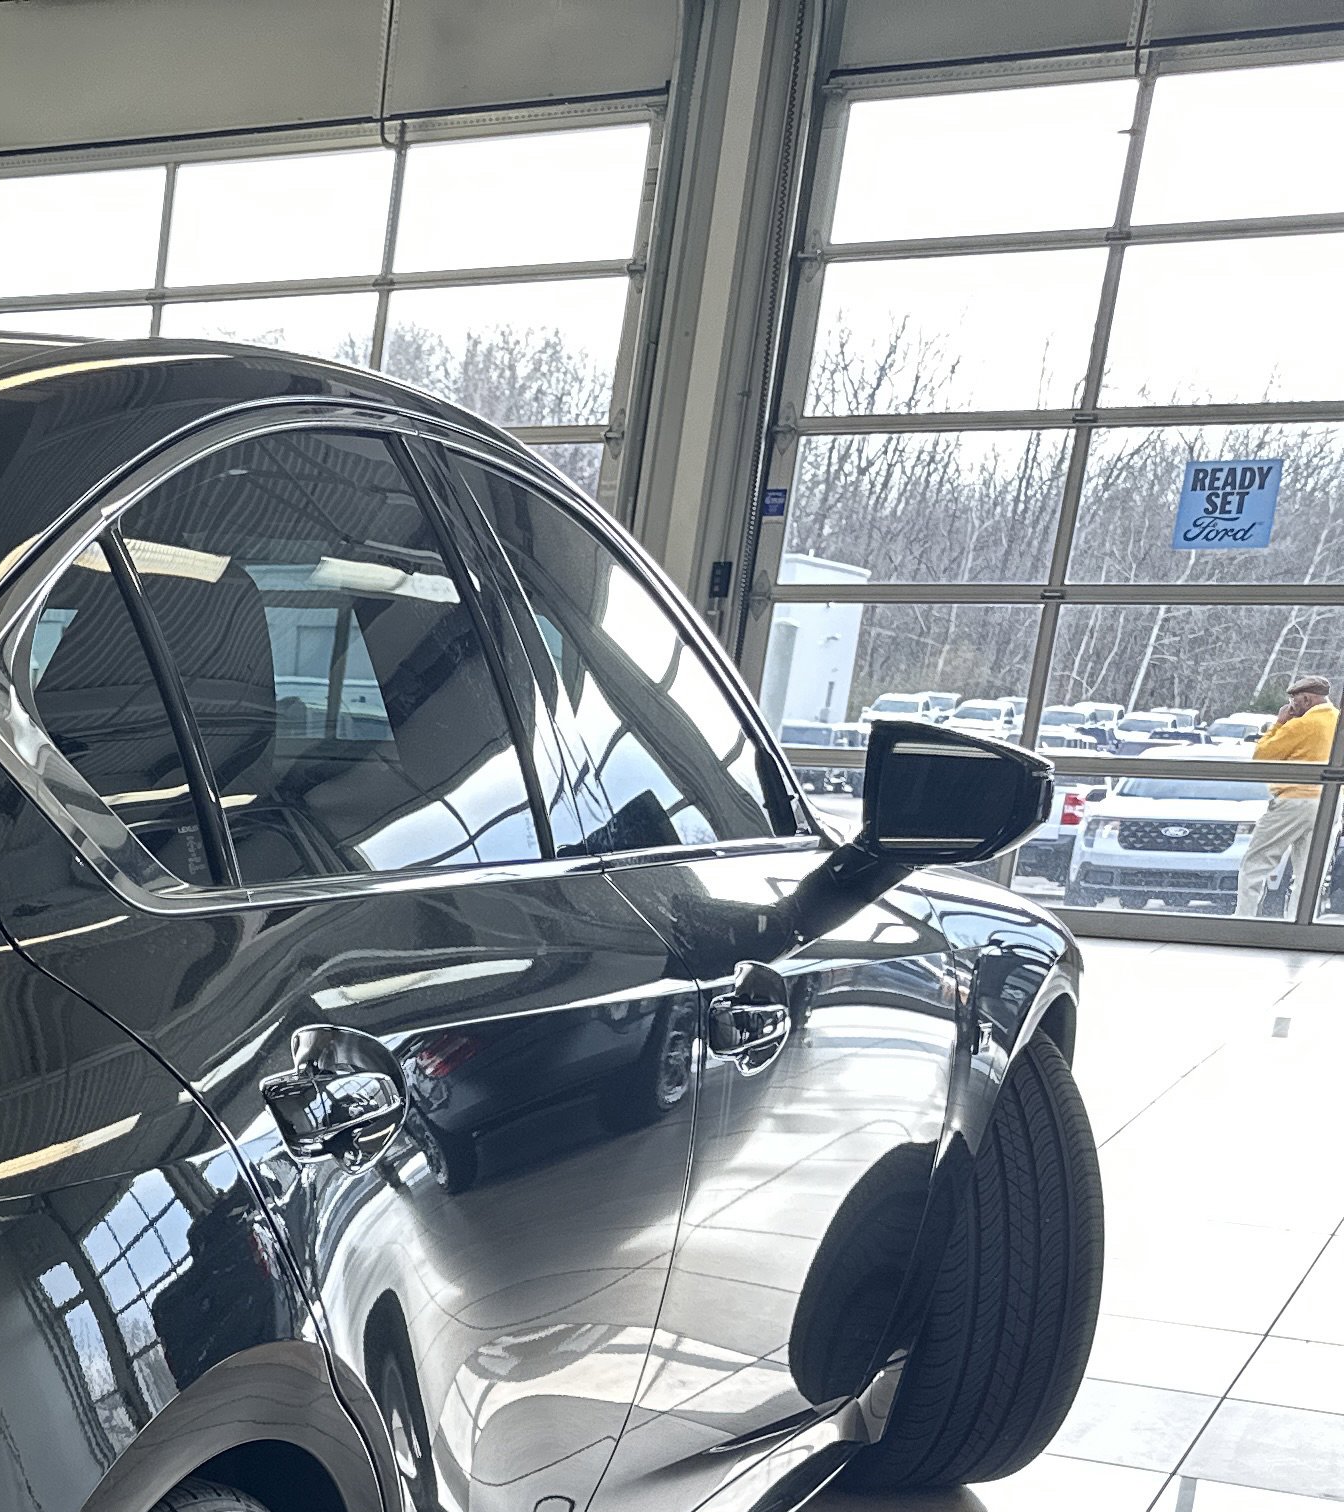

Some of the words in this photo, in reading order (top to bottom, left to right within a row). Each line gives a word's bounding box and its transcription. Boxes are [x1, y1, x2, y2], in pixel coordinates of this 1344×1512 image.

[1191, 466, 1273, 491] READY
[1203, 491, 1250, 515] SET
[1182, 516, 1257, 542] Ford
